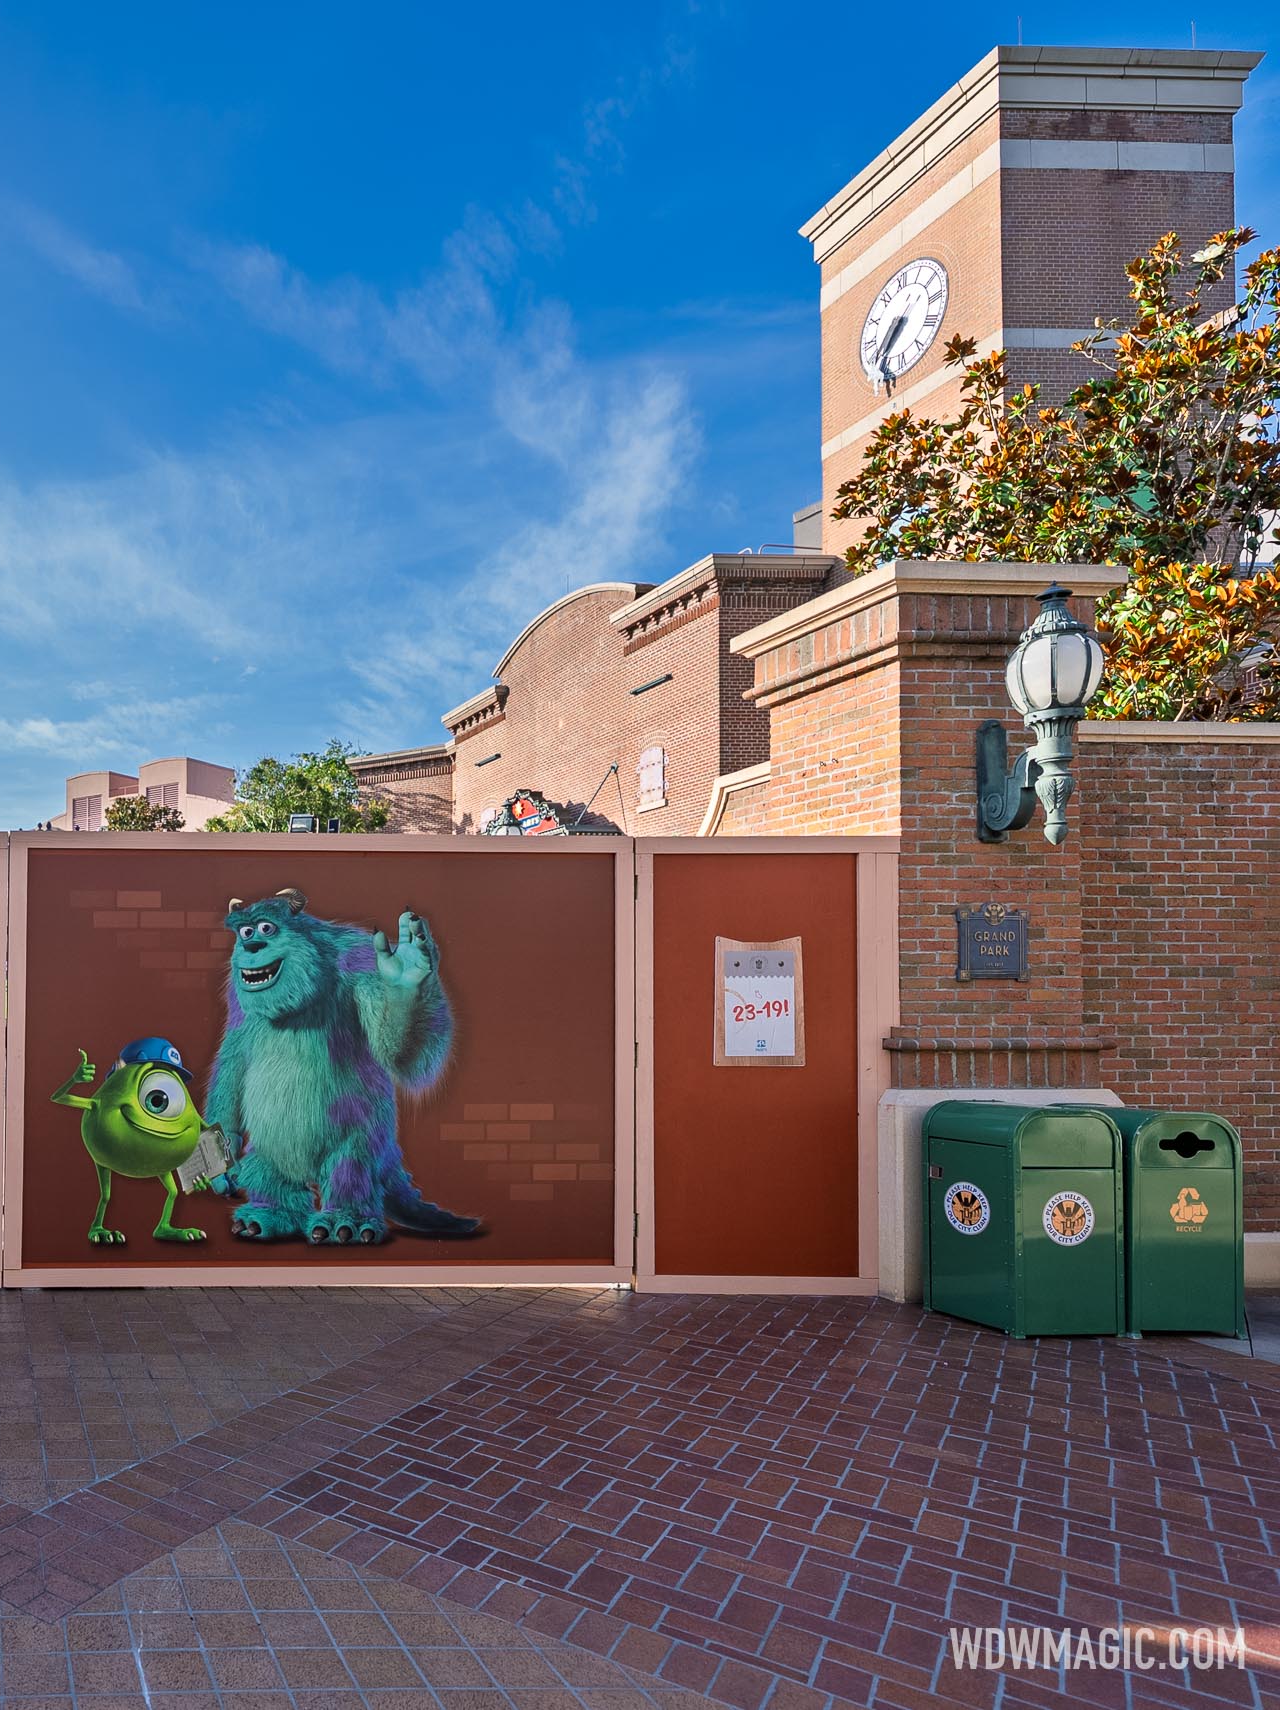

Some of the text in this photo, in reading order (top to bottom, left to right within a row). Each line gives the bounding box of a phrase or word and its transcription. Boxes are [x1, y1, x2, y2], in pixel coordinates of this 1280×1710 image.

[974, 931, 1016, 942] GRAND
[980, 945, 1009, 956] PARK
[732, 999, 790, 1022] 23-19!
[946, 1184, 988, 1210] PLEASE HELP KEEP
[1045, 1193, 1092, 1217] PLEASE HELP KEEP
[947, 1210, 987, 1232] OUR CITY CLEAN
[1176, 1225, 1203, 1233] RECYCLE
[1046, 1223, 1058, 1238] OUR
[1074, 1224, 1091, 1242] CLEAN
